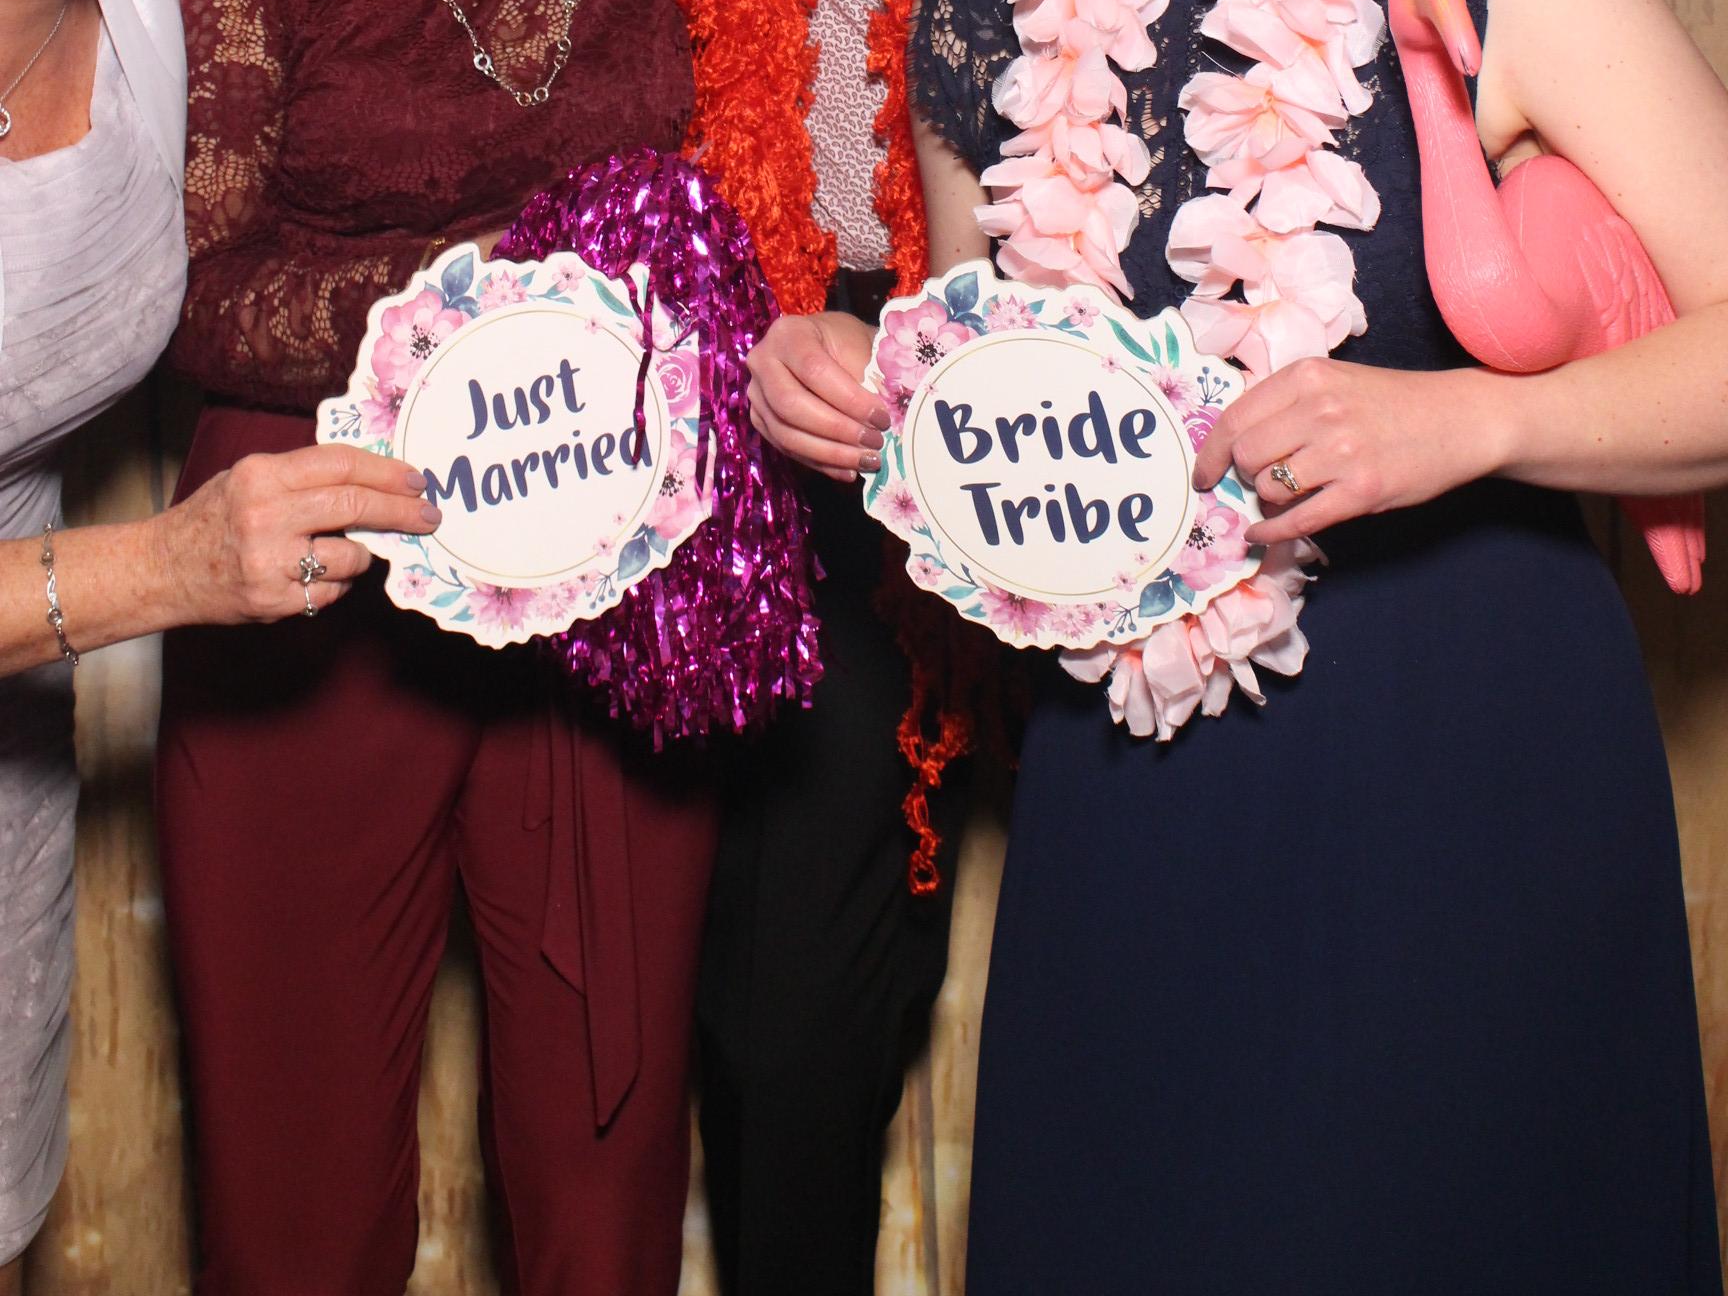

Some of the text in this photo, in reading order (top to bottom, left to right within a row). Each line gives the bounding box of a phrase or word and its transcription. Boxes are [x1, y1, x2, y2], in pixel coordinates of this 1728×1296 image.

[466, 358, 586, 439] Just
[933, 390, 1157, 464] Bride
[422, 422, 653, 513] Married
[958, 481, 1154, 546] Tribe
